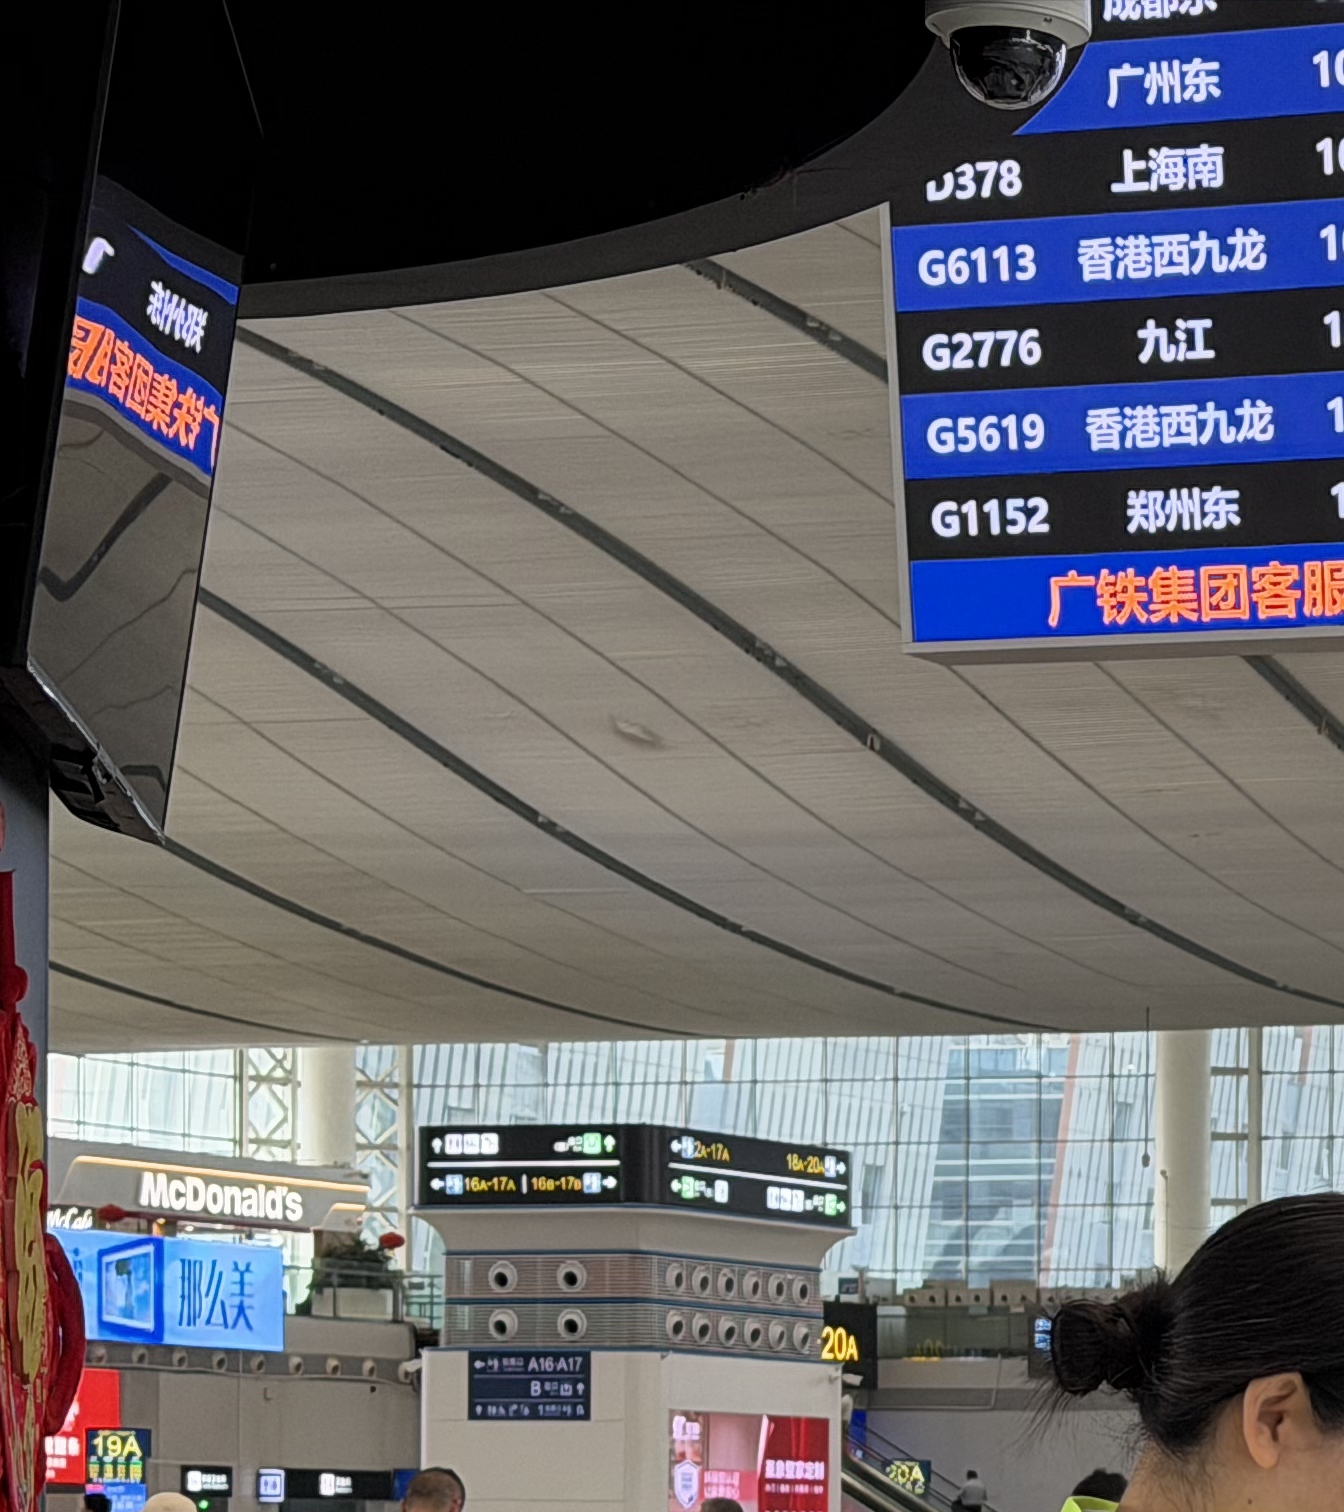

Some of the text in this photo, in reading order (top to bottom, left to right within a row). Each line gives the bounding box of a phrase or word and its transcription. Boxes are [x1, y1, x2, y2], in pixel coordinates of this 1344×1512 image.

[1108, 58, 1221, 107] 广州东
[1111, 144, 1224, 192] 上海南
[919, 245, 1036, 286] G6113
[1078, 228, 1266, 281] 香港西九龙
[923, 329, 1041, 370] G2776
[1138, 319, 1215, 363] 九江
[927, 414, 1044, 453] G5619
[1086, 399, 1274, 451] 香港西九龙
[932, 497, 1049, 537] G1152
[1127, 486, 1241, 533] 郑州东
[140, 1171, 303, 1222] McDonald's
[178, 1258, 254, 1331] 那么美
[92, 1434, 143, 1457] 19A
